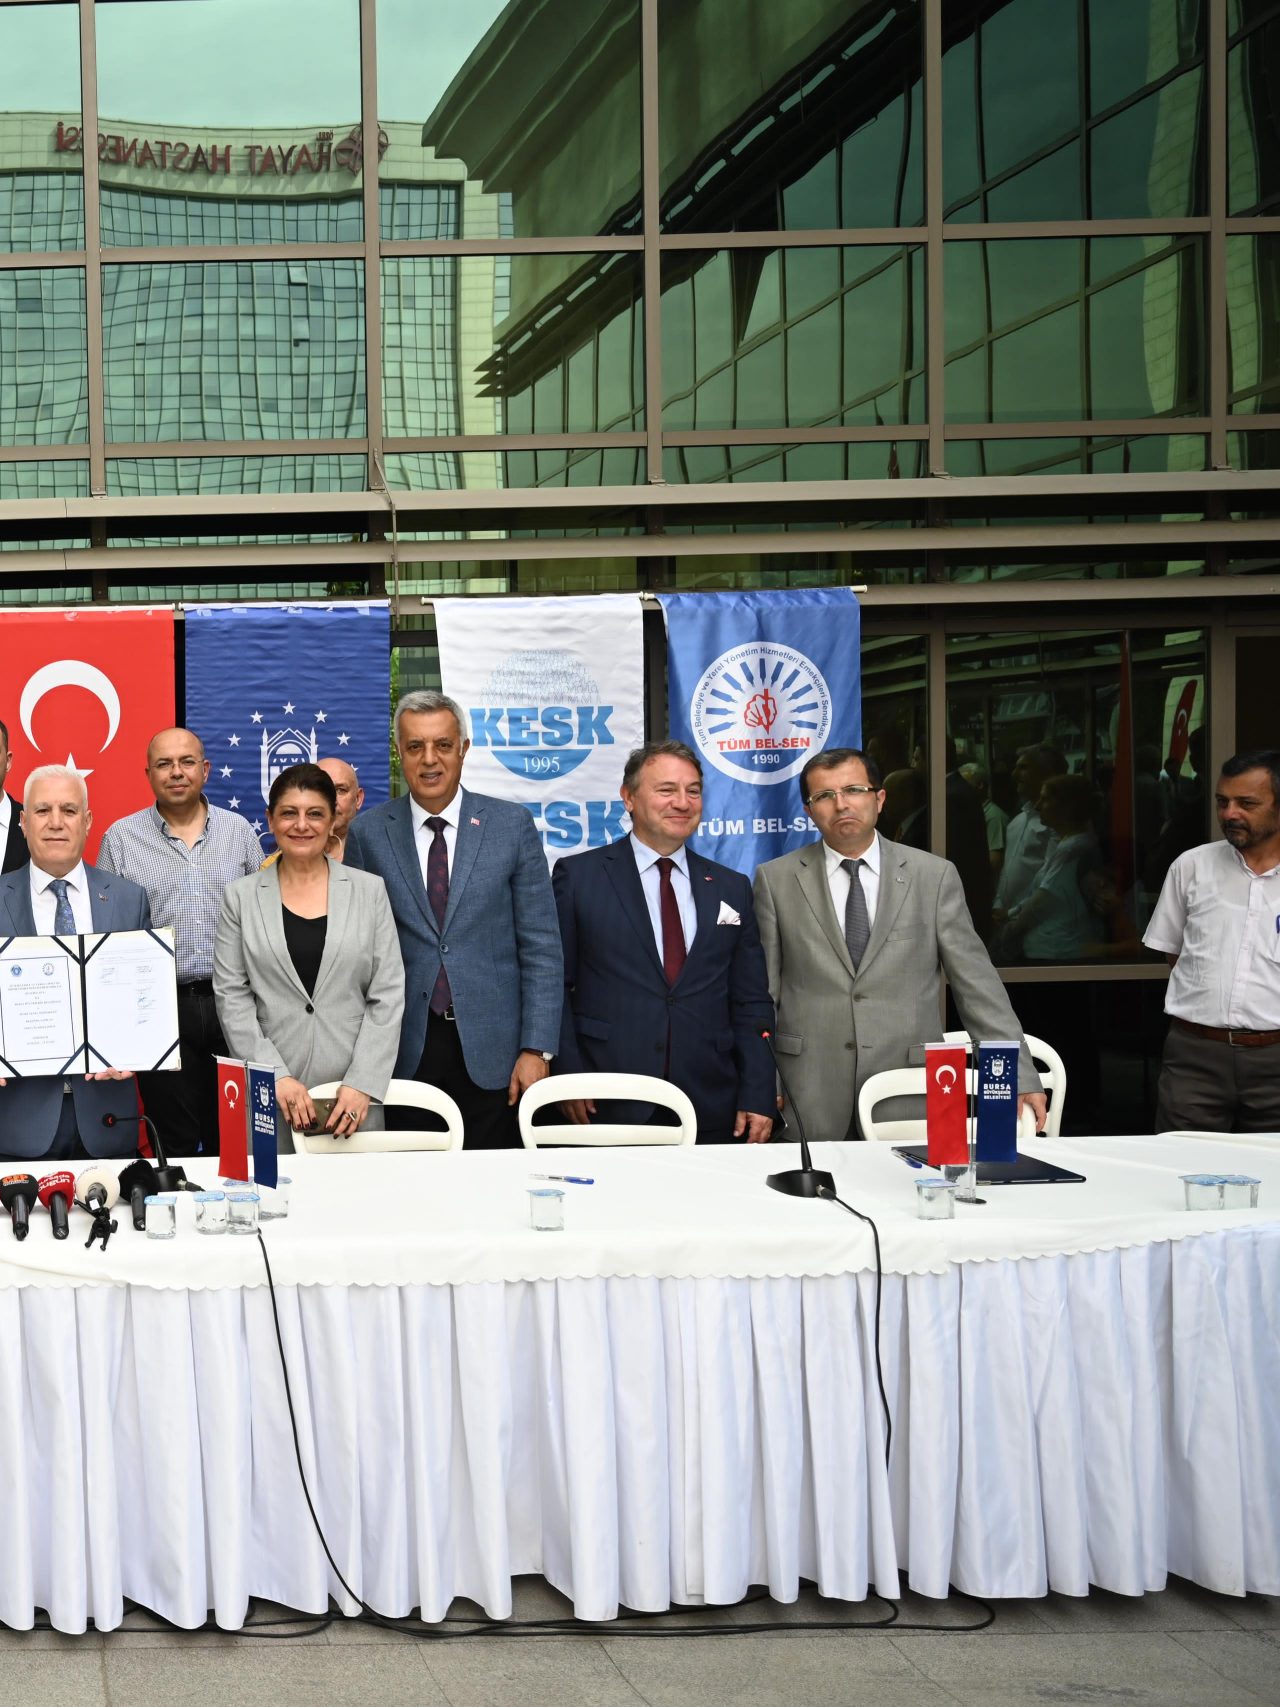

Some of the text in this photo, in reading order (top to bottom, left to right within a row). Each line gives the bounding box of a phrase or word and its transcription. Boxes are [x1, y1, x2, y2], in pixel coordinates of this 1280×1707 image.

[694, 692, 704, 727] Belediye
[702, 682, 710, 692] ve
[706, 663, 724, 681] Yerel
[724, 648, 759, 665] Yönetim
[760, 647, 800, 663] Hizmetleri
[799, 661, 825, 698] Emekçileri
[818, 700, 829, 739] Sendikası
[470, 706, 615, 747] KESK
[717, 737, 810, 751] TÜM BEL-SEN
[523, 756, 560, 773] 1995
[752, 754, 780, 765] 1990
[697, 816, 819, 837] TÜM BEL-SE
[255, 1112, 274, 1124] BURSA
